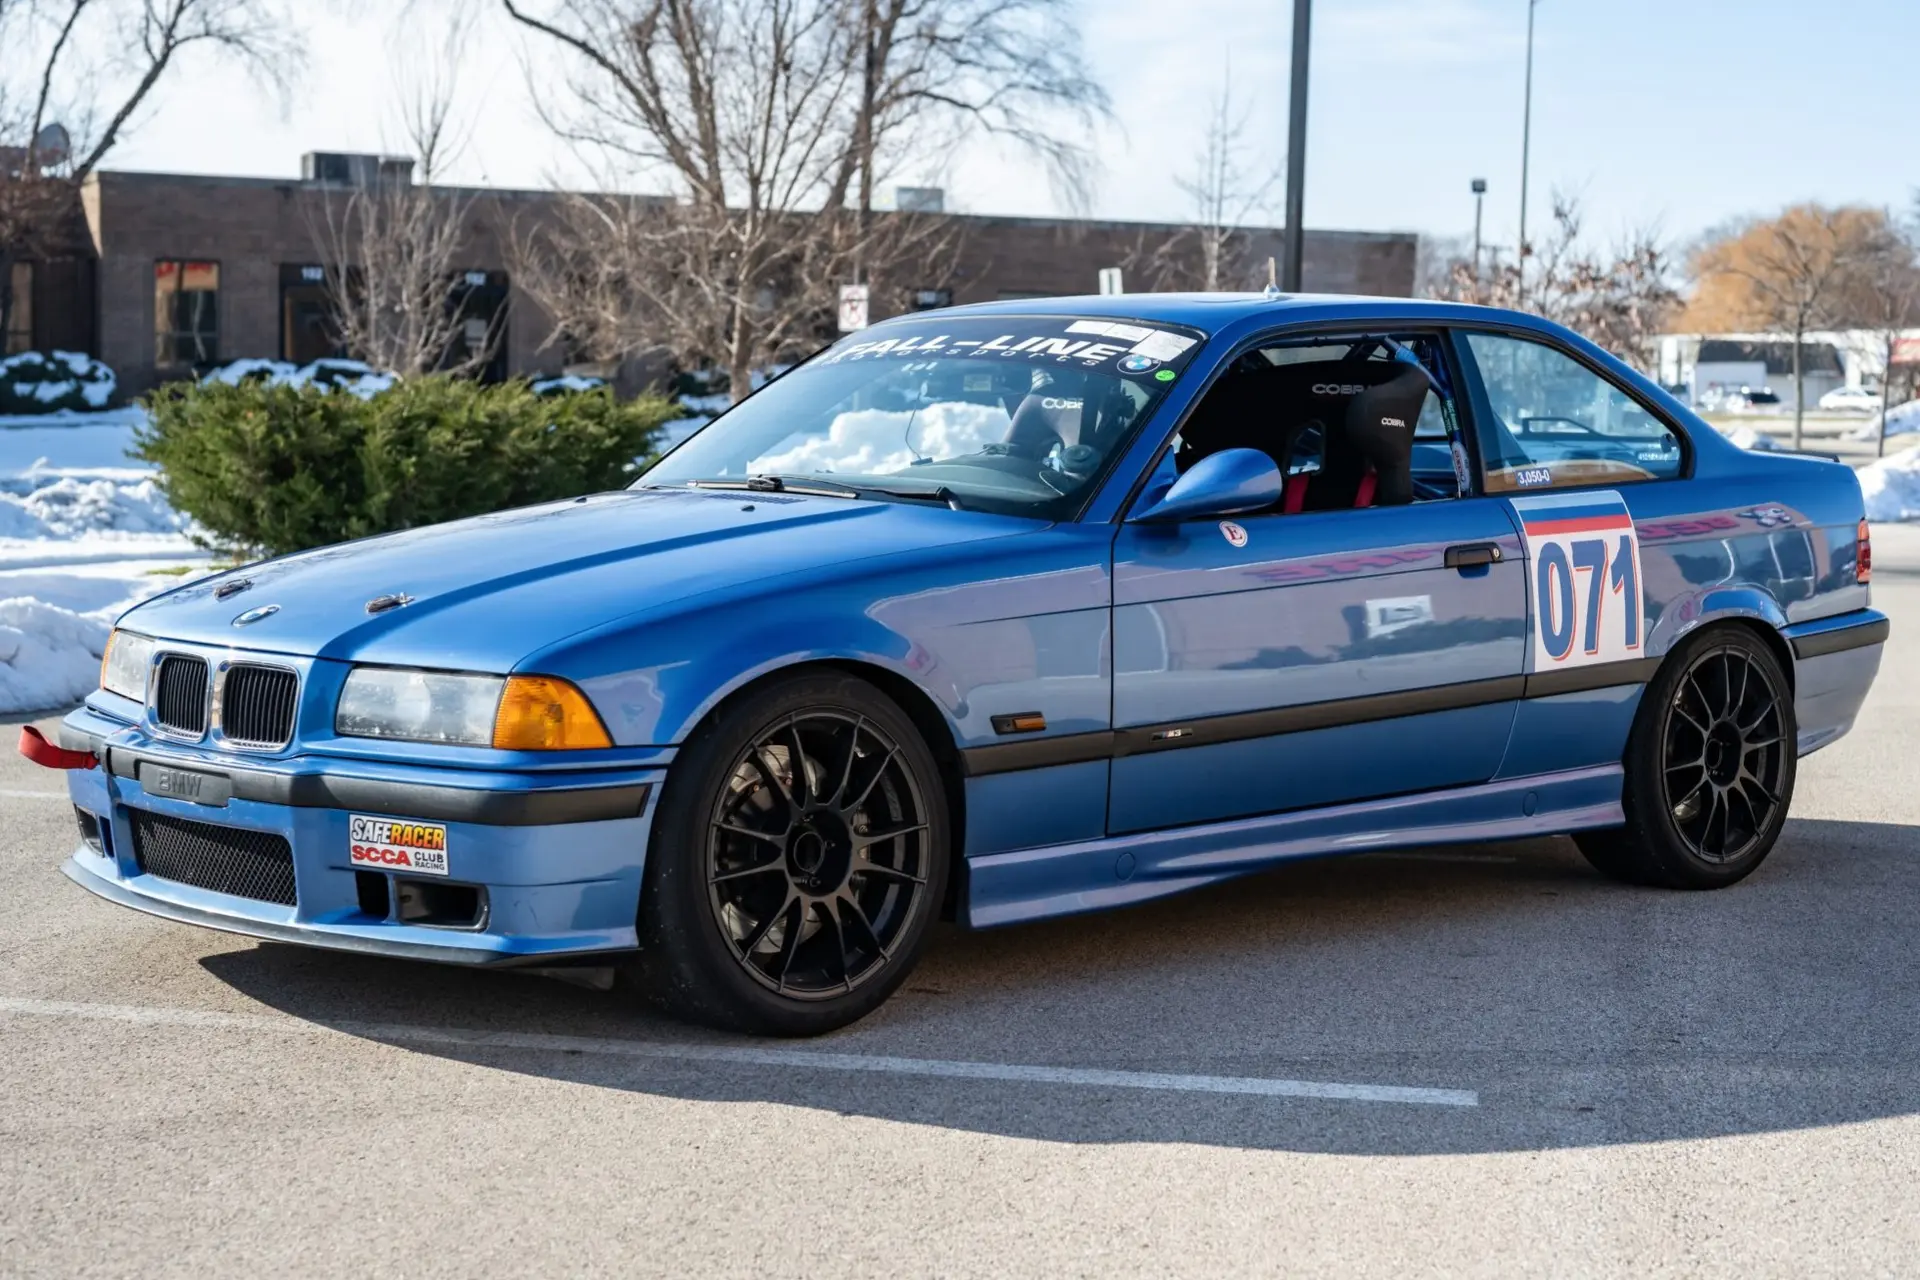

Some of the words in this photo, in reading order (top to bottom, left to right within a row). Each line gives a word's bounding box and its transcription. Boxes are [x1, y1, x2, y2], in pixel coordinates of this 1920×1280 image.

[838, 335, 1128, 361] FALL-LINE
[1311, 383, 1372, 395] COBR
[1041, 397, 1084, 409] COB
[1381, 417, 1405, 428] COBRA
[1538, 535, 1639, 662] 071
[159, 768, 202, 797] BMW
[352, 818, 445, 851] SAFERACER
[352, 845, 412, 866] SCCA
[414, 852, 444, 863] CLUB
[415, 861, 445, 871] RACING
